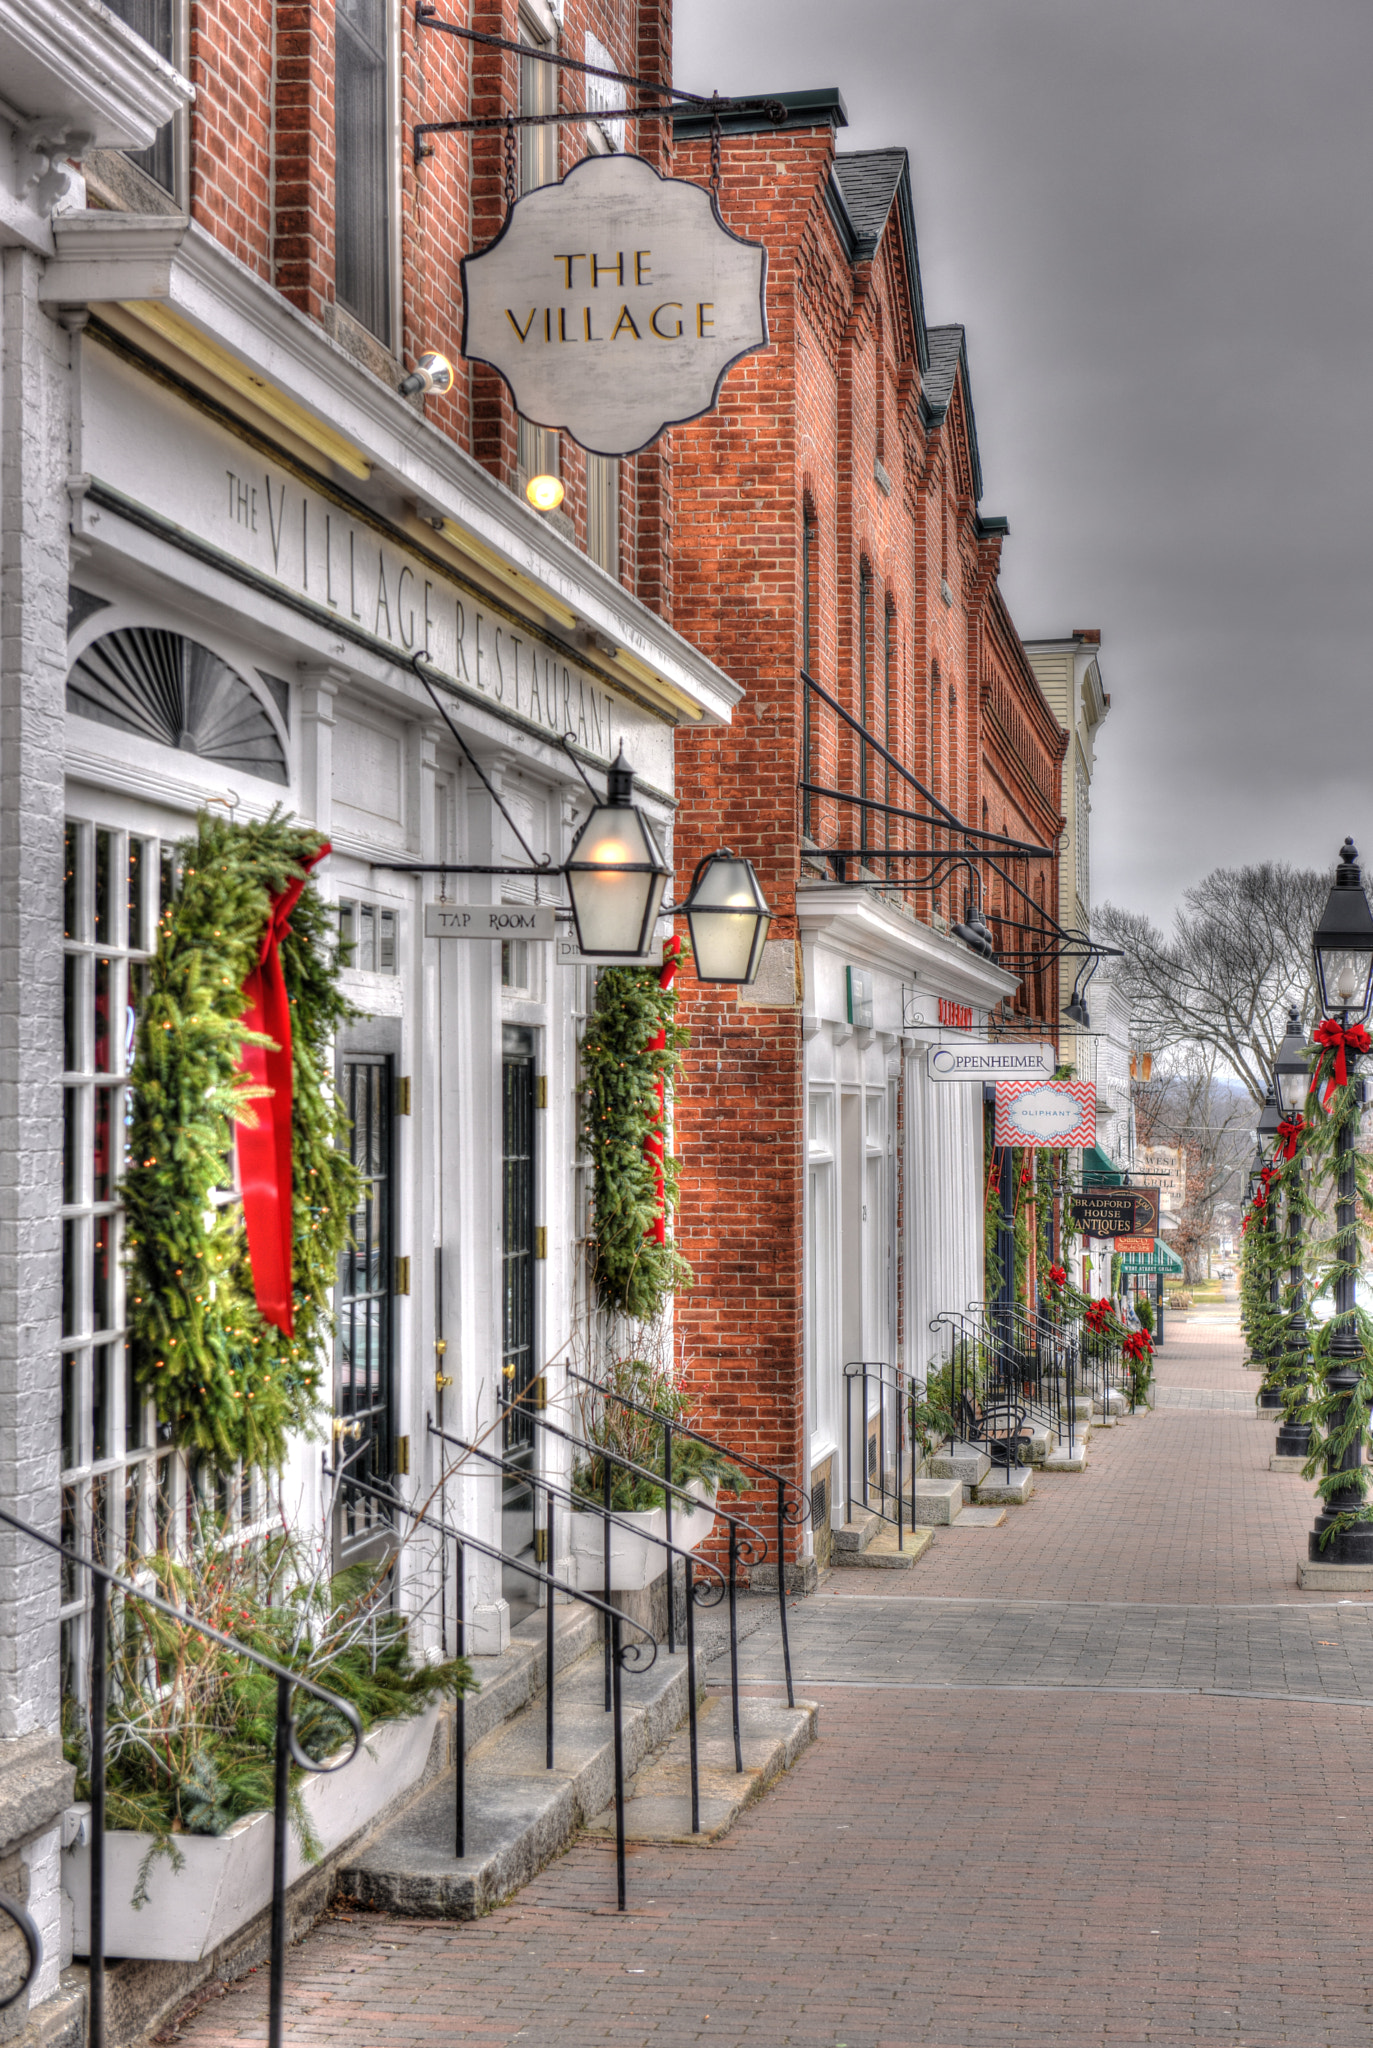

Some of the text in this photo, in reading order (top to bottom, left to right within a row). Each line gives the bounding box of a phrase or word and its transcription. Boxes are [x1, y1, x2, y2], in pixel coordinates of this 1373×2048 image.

[553, 250, 653, 290] THE
[504, 302, 716, 344] VILLAGE
[226, 470, 614, 760] THE VILLAGE RESTAURANT
[438, 913, 537, 930] TAP ROOM
[933, 1050, 1051, 1073] OPPENHEIMER
[1146, 1157, 1176, 1166] WEST
[1144, 1179, 1176, 1188] GRILL
[1075, 1200, 1132, 1209] BRADFORD
[1084, 1209, 1121, 1218] HOUSE
[1074, 1218, 1131, 1236] ANTIQUES
